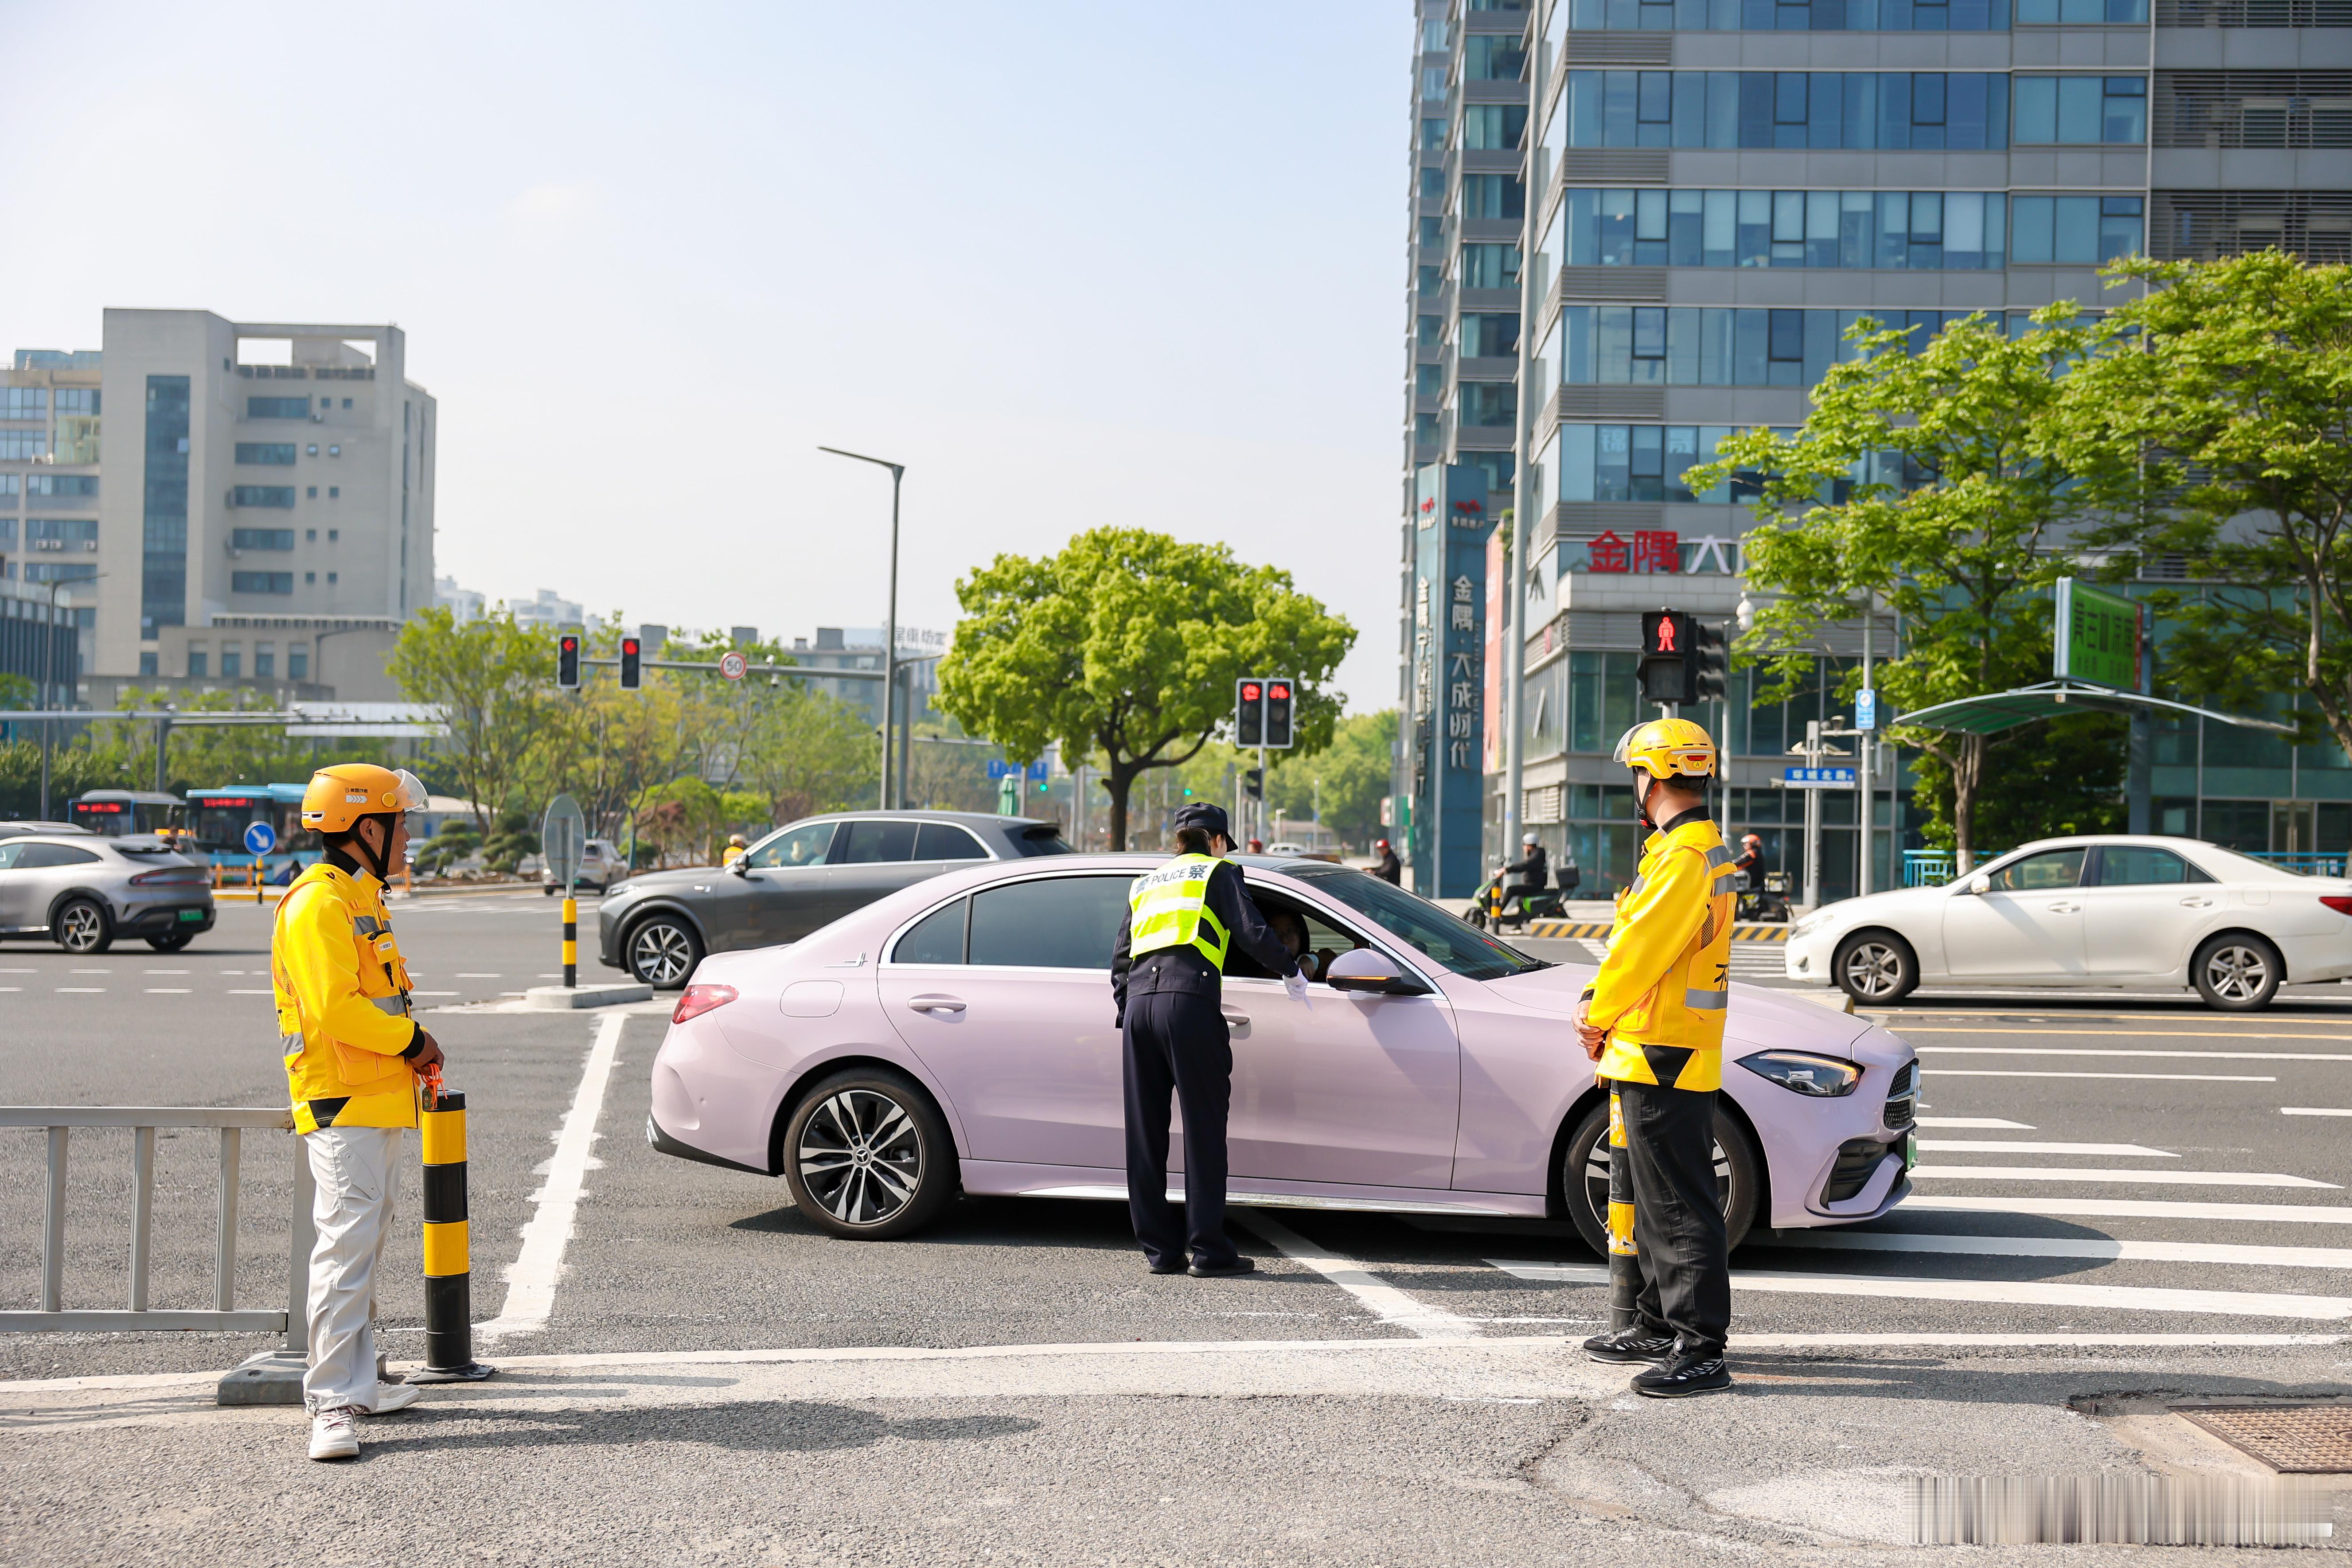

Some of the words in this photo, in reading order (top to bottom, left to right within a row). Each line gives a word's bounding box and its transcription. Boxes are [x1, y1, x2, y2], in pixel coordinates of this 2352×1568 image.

[1587, 529, 1745, 575] 金隅大
[726, 659, 743, 672] 50
[1135, 876, 1151, 894] 警
[1151, 868, 1187, 885] POLICE
[1188, 865, 1208, 879] 察
